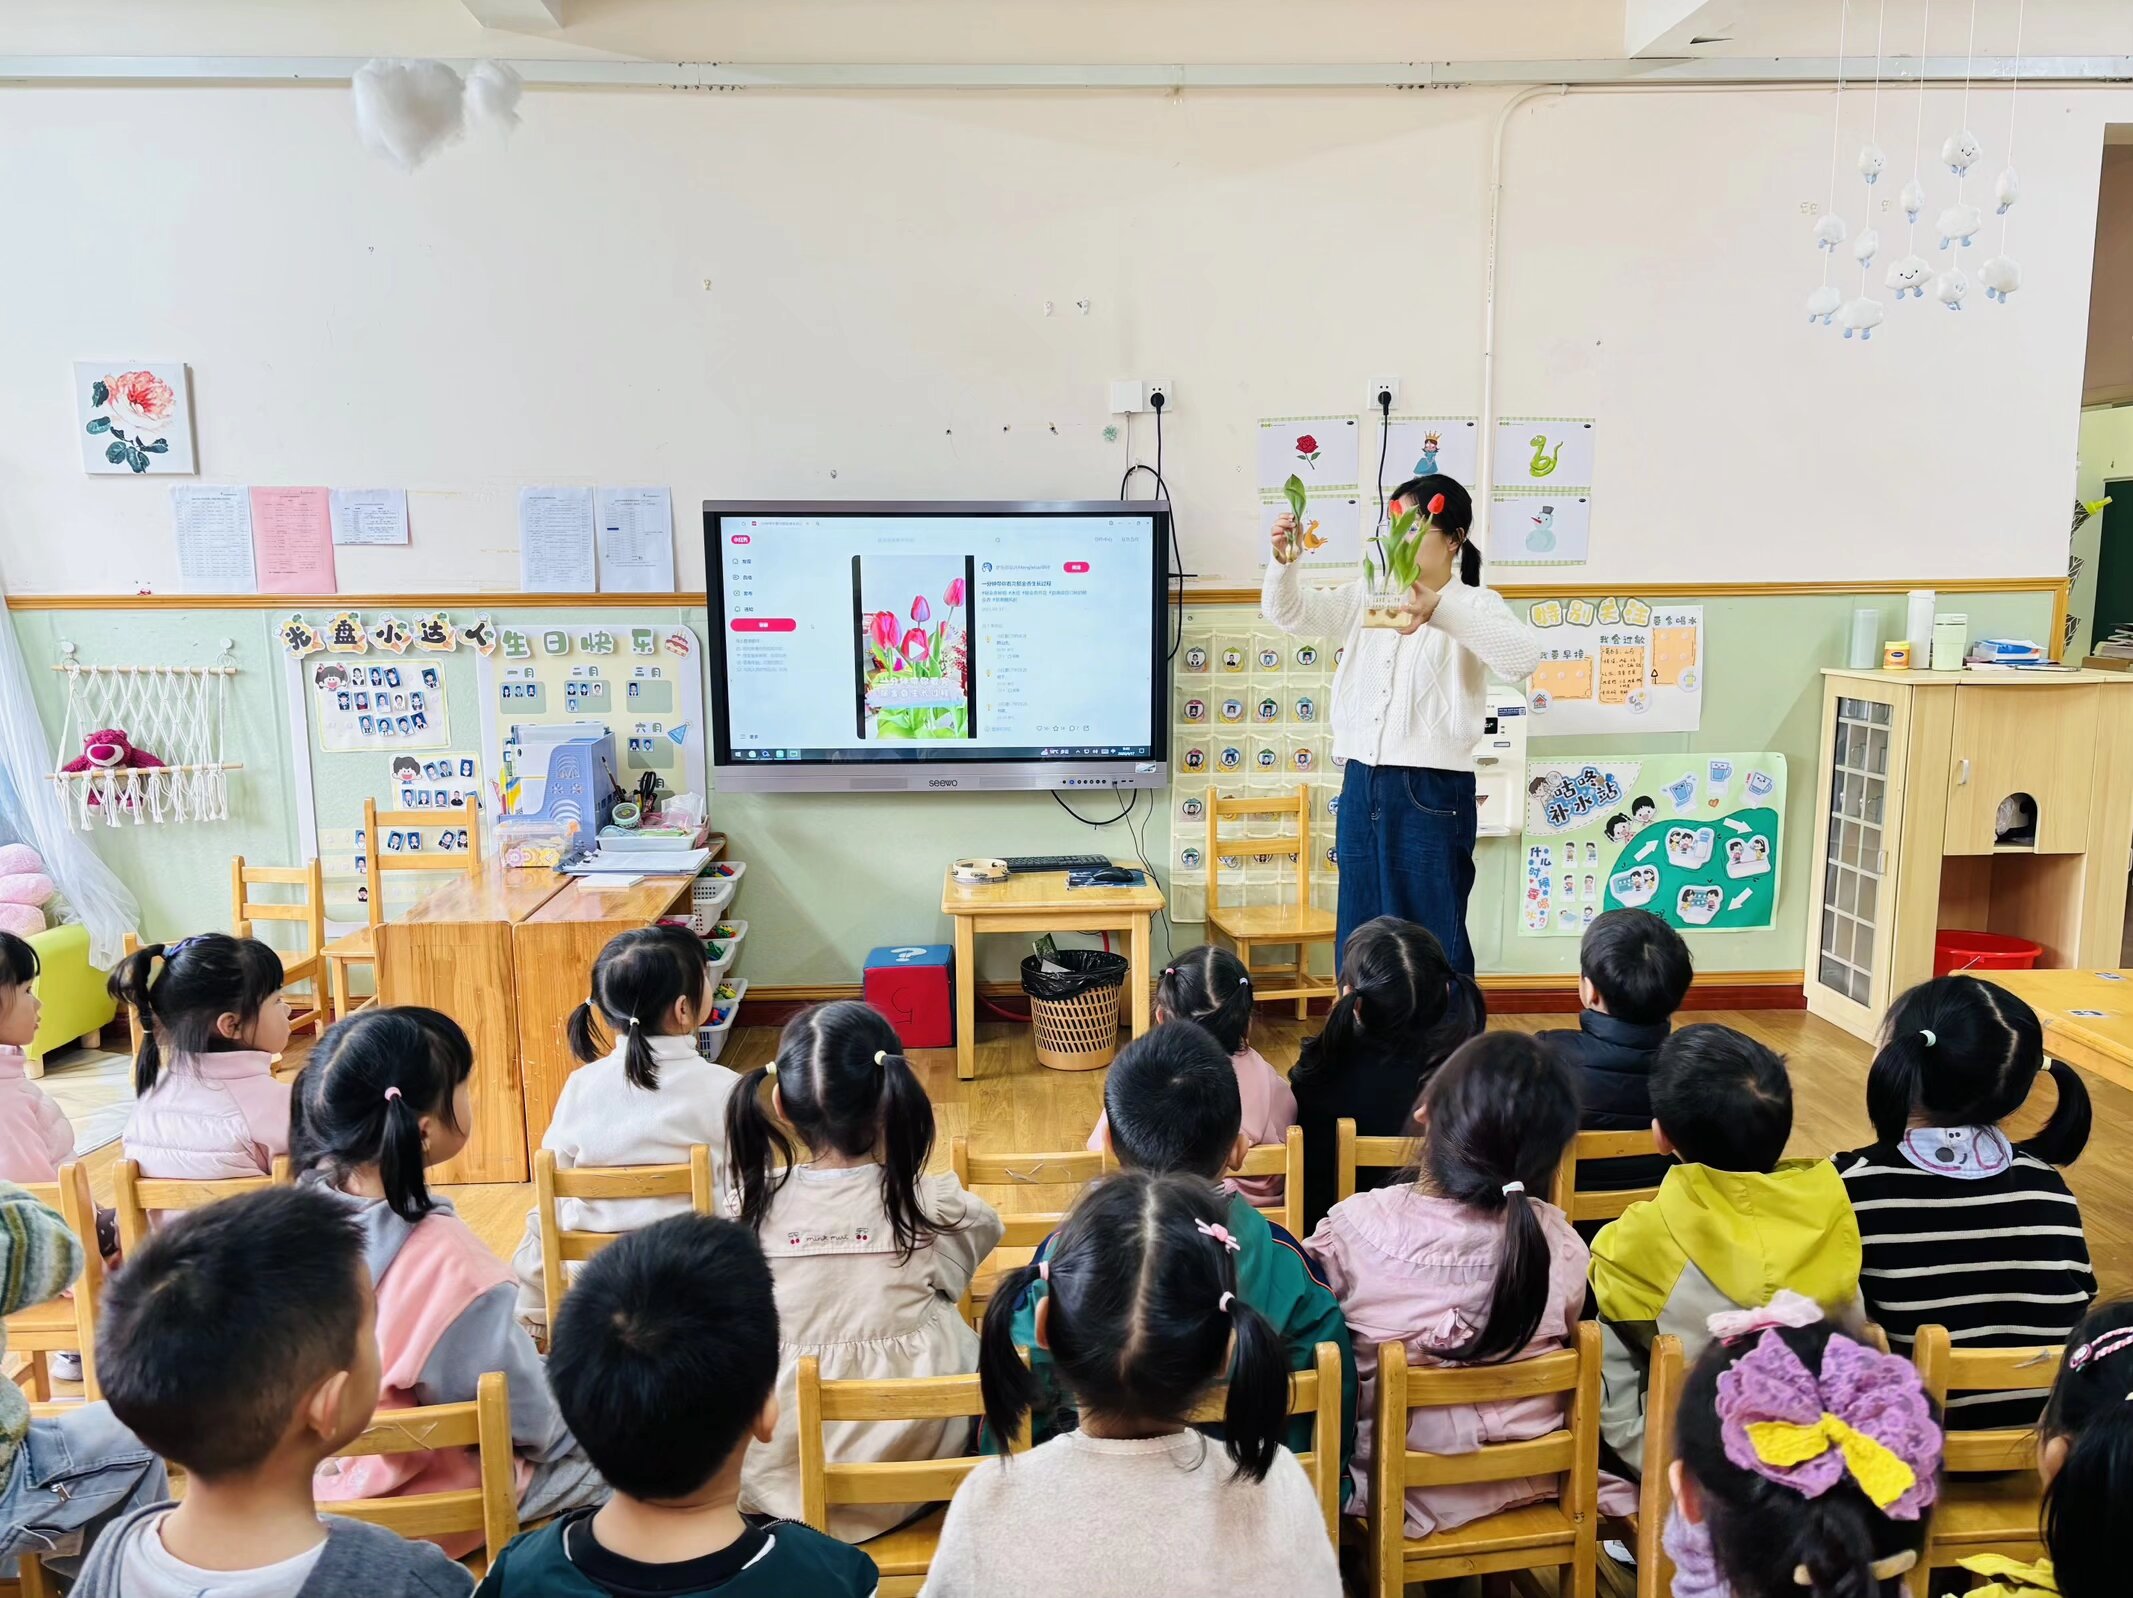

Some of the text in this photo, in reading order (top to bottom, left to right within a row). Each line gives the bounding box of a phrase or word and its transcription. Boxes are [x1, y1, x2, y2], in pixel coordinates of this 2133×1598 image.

[1533, 597, 1649, 626] 特别关注
[284, 620, 488, 650] 光盘小达人
[502, 629, 653, 657] 生日快乐
[507, 667, 535, 679] 一月
[572, 665, 599, 677] 二月
[635, 666, 662, 679] 三月
[635, 722, 663, 734] 六月
[928, 779, 958, 787] seewo
[1554, 770, 1601, 800] 咕咚
[1549, 782, 1619, 825] 补水站
